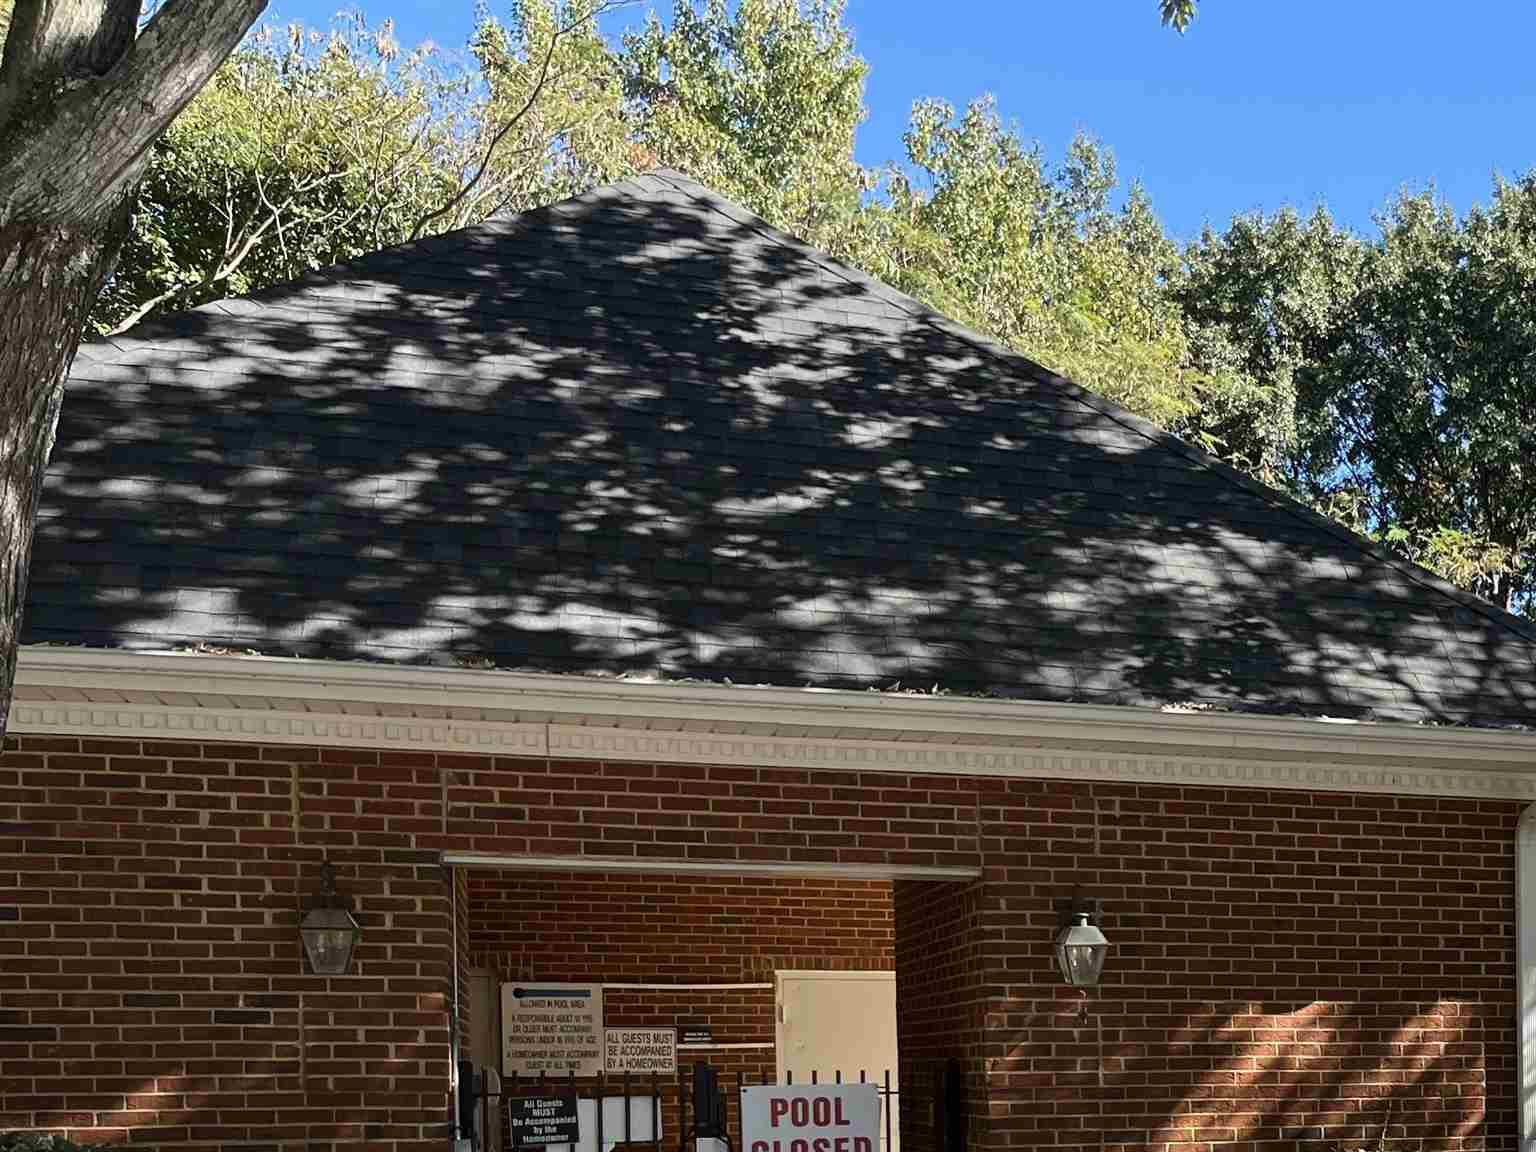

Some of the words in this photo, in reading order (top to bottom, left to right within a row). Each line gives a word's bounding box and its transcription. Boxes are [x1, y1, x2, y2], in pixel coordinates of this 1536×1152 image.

[607, 1031, 620, 1043] ALL
[622, 1031, 651, 1043] GUESTS
[652, 1031, 673, 1043] MUST
[608, 1045, 619, 1057] BE
[620, 1045, 673, 1057] ACCOMPANIED
[607, 1058, 617, 1070] BY
[619, 1058, 625, 1070] A
[626, 1058, 673, 1070] HOMEOWNER
[537, 1099, 563, 1108] Guests
[532, 1108, 556, 1117] MUST
[770, 1096, 851, 1128] POOL
[524, 1115, 577, 1126] Accompanied
[533, 1126, 543, 1135] by
